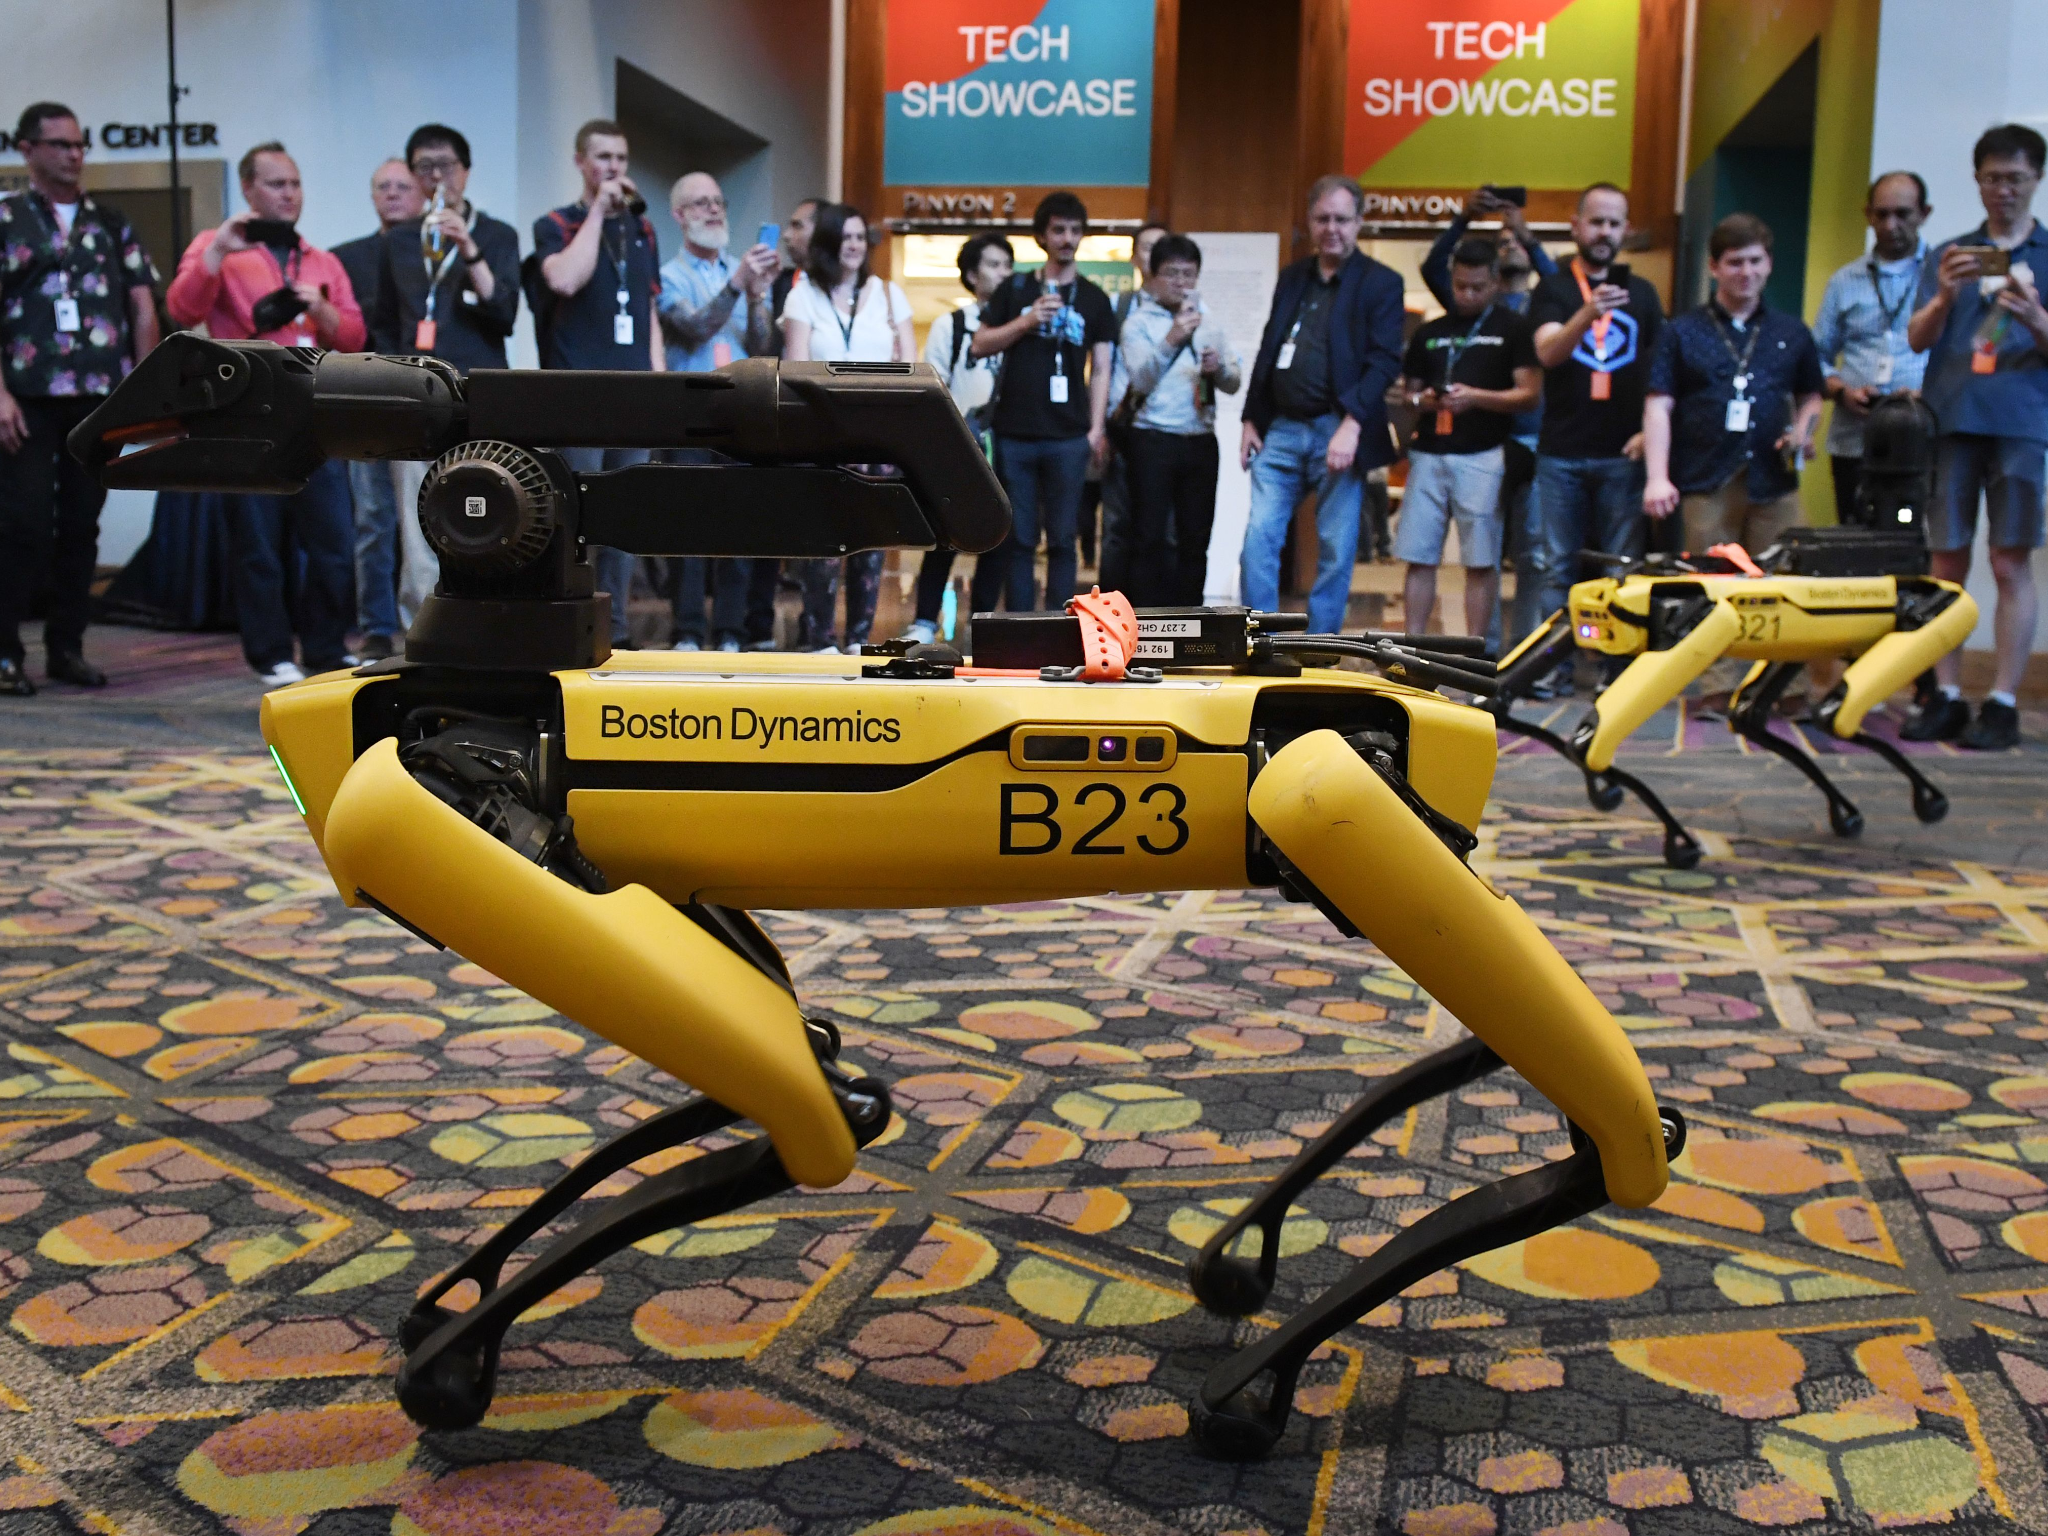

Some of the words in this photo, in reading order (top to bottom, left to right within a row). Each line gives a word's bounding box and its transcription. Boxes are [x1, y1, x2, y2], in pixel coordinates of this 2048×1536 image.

[957, 24, 1070, 63] TECH
[1426, 21, 1547, 60] TECH
[901, 79, 1138, 118] SHOWCASE
[1363, 78, 1619, 117] SHOWCASE
[101, 123, 219, 148] CENTER
[903, 192, 994, 212] PINYON
[1002, 192, 1017, 212] 2
[1364, 193, 1463, 215] PINYON
[1161, 623, 1187, 633] 2.237
[1151, 644, 1169, 654] 192
[600, 705, 722, 740] Boston
[731, 707, 901, 750] Dynamics
[999, 783, 1190, 855] B23
